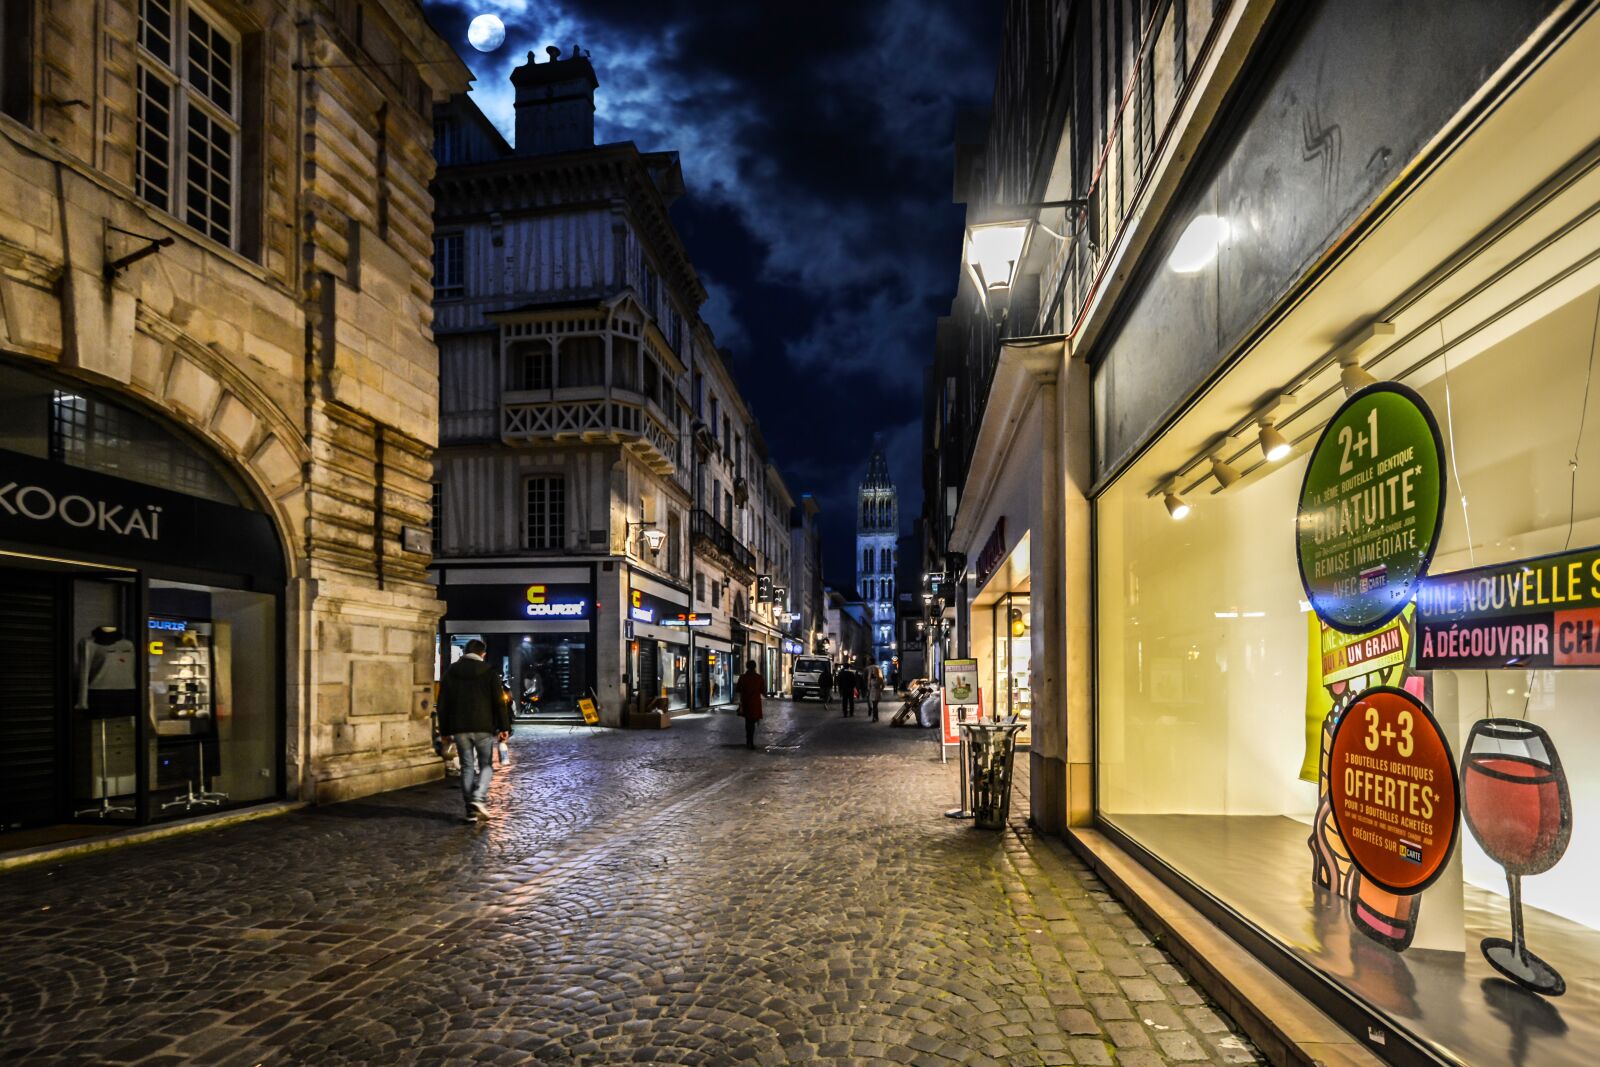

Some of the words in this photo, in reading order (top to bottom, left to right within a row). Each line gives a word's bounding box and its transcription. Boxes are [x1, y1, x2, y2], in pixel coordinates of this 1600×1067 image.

[1338, 408, 1378, 476] 2+1
[1341, 467, 1373, 493] BOUTEILLE
[1377, 446, 1414, 476] IDENTIQUE
[0, 481, 163, 541] KOOKAÏ
[1315, 551, 1350, 579] REMISE
[1354, 529, 1417, 567] IMMÉDIATE
[1333, 576, 1357, 599] AVEC
[1422, 581, 1457, 617] UNE
[1463, 562, 1583, 612] NOUVELLE
[1347, 643, 1362, 664] UN
[1365, 629, 1399, 658] GRAIN
[1423, 626, 1434, 658] À
[1437, 624, 1549, 658] DÉCOUVRIR
[1364, 707, 1414, 758] 3+3
[1345, 752, 1350, 763] 3
[1350, 753, 1388, 772] BOUTEILLES
[1390, 761, 1434, 782] IDENTIQUES
[1344, 798, 1359, 813] POUR
[1365, 804, 1399, 825] BOUTEILLES
[1400, 815, 1433, 836] ACHETÉES
[1352, 826, 1383, 848] CRÉDITÉES
[1384, 838, 1397, 853] SUR
[1407, 848, 1421, 862] CARTE
